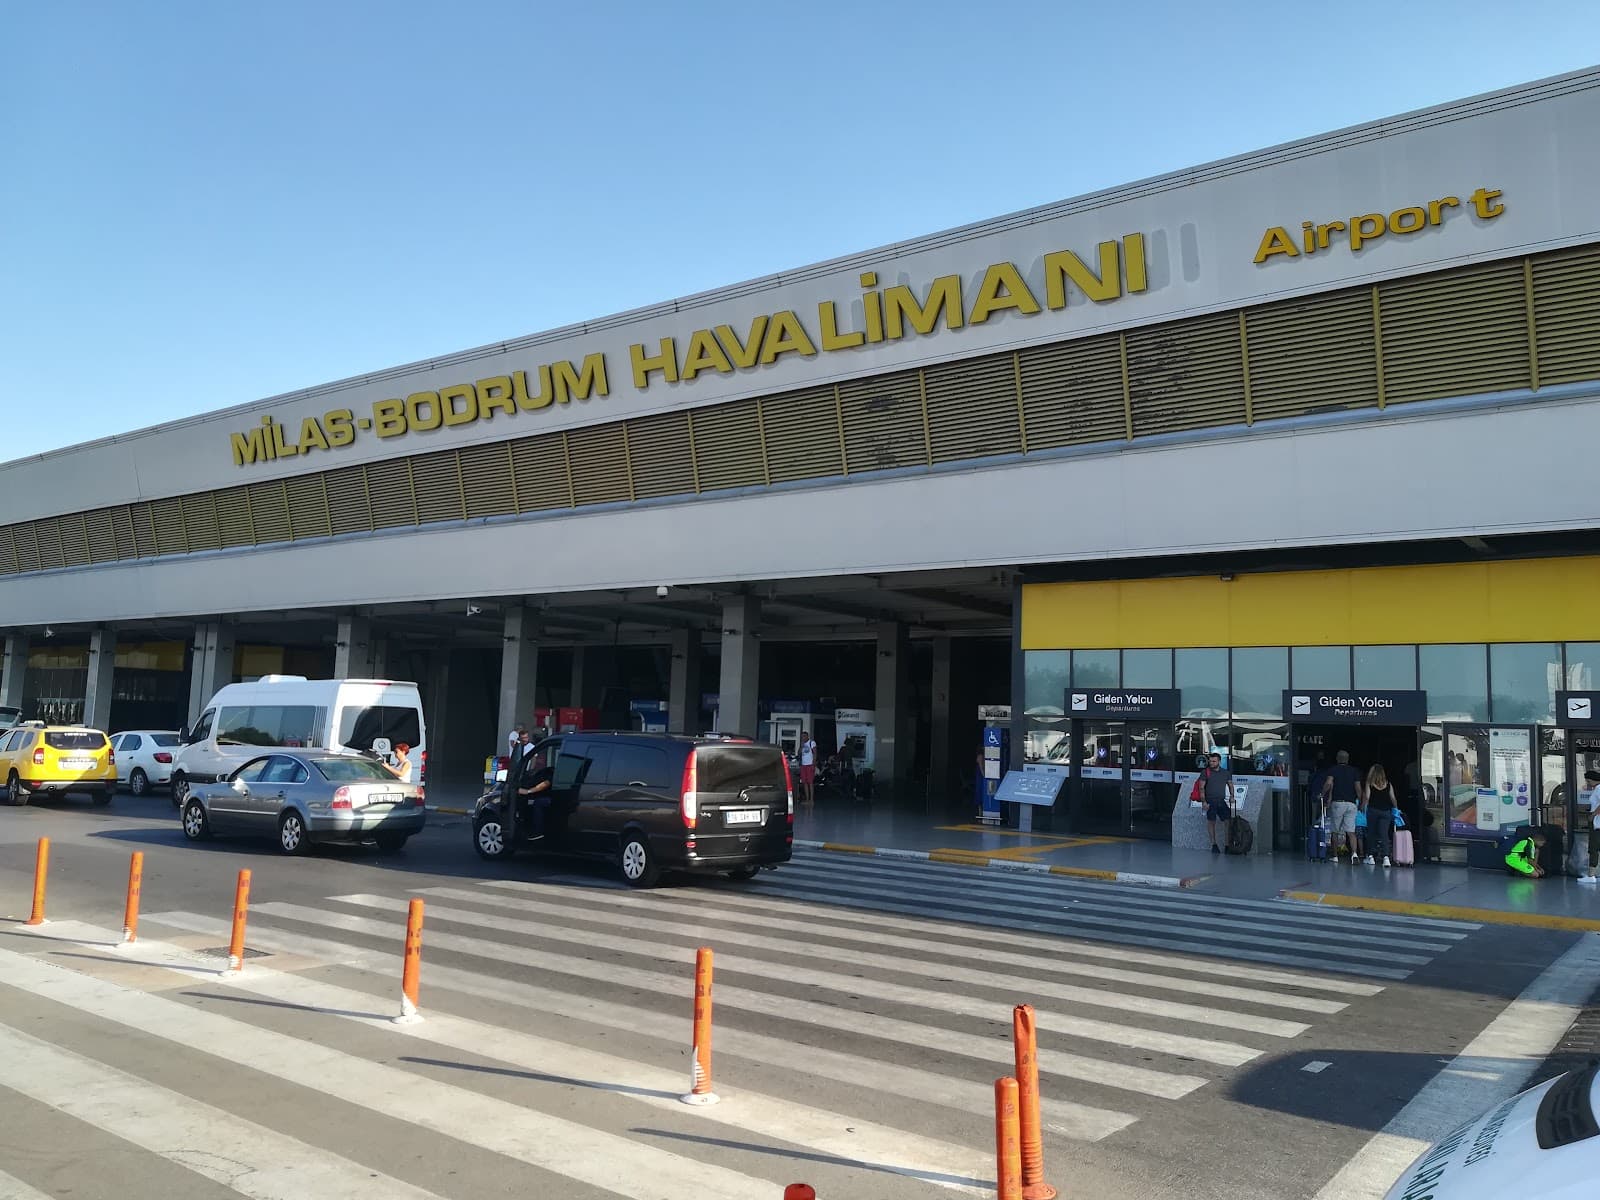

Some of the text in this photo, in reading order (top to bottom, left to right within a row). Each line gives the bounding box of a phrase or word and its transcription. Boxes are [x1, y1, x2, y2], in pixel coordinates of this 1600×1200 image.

[231, 188, 1504, 465] MİLAS-BODRUM HAVALİMANI Airport
[1094, 694, 1153, 704] Giden Yolcu
[1319, 696, 1393, 708] Giden Yolcu
[1106, 705, 1141, 713] Departures
[1334, 708, 1377, 716] Departures
